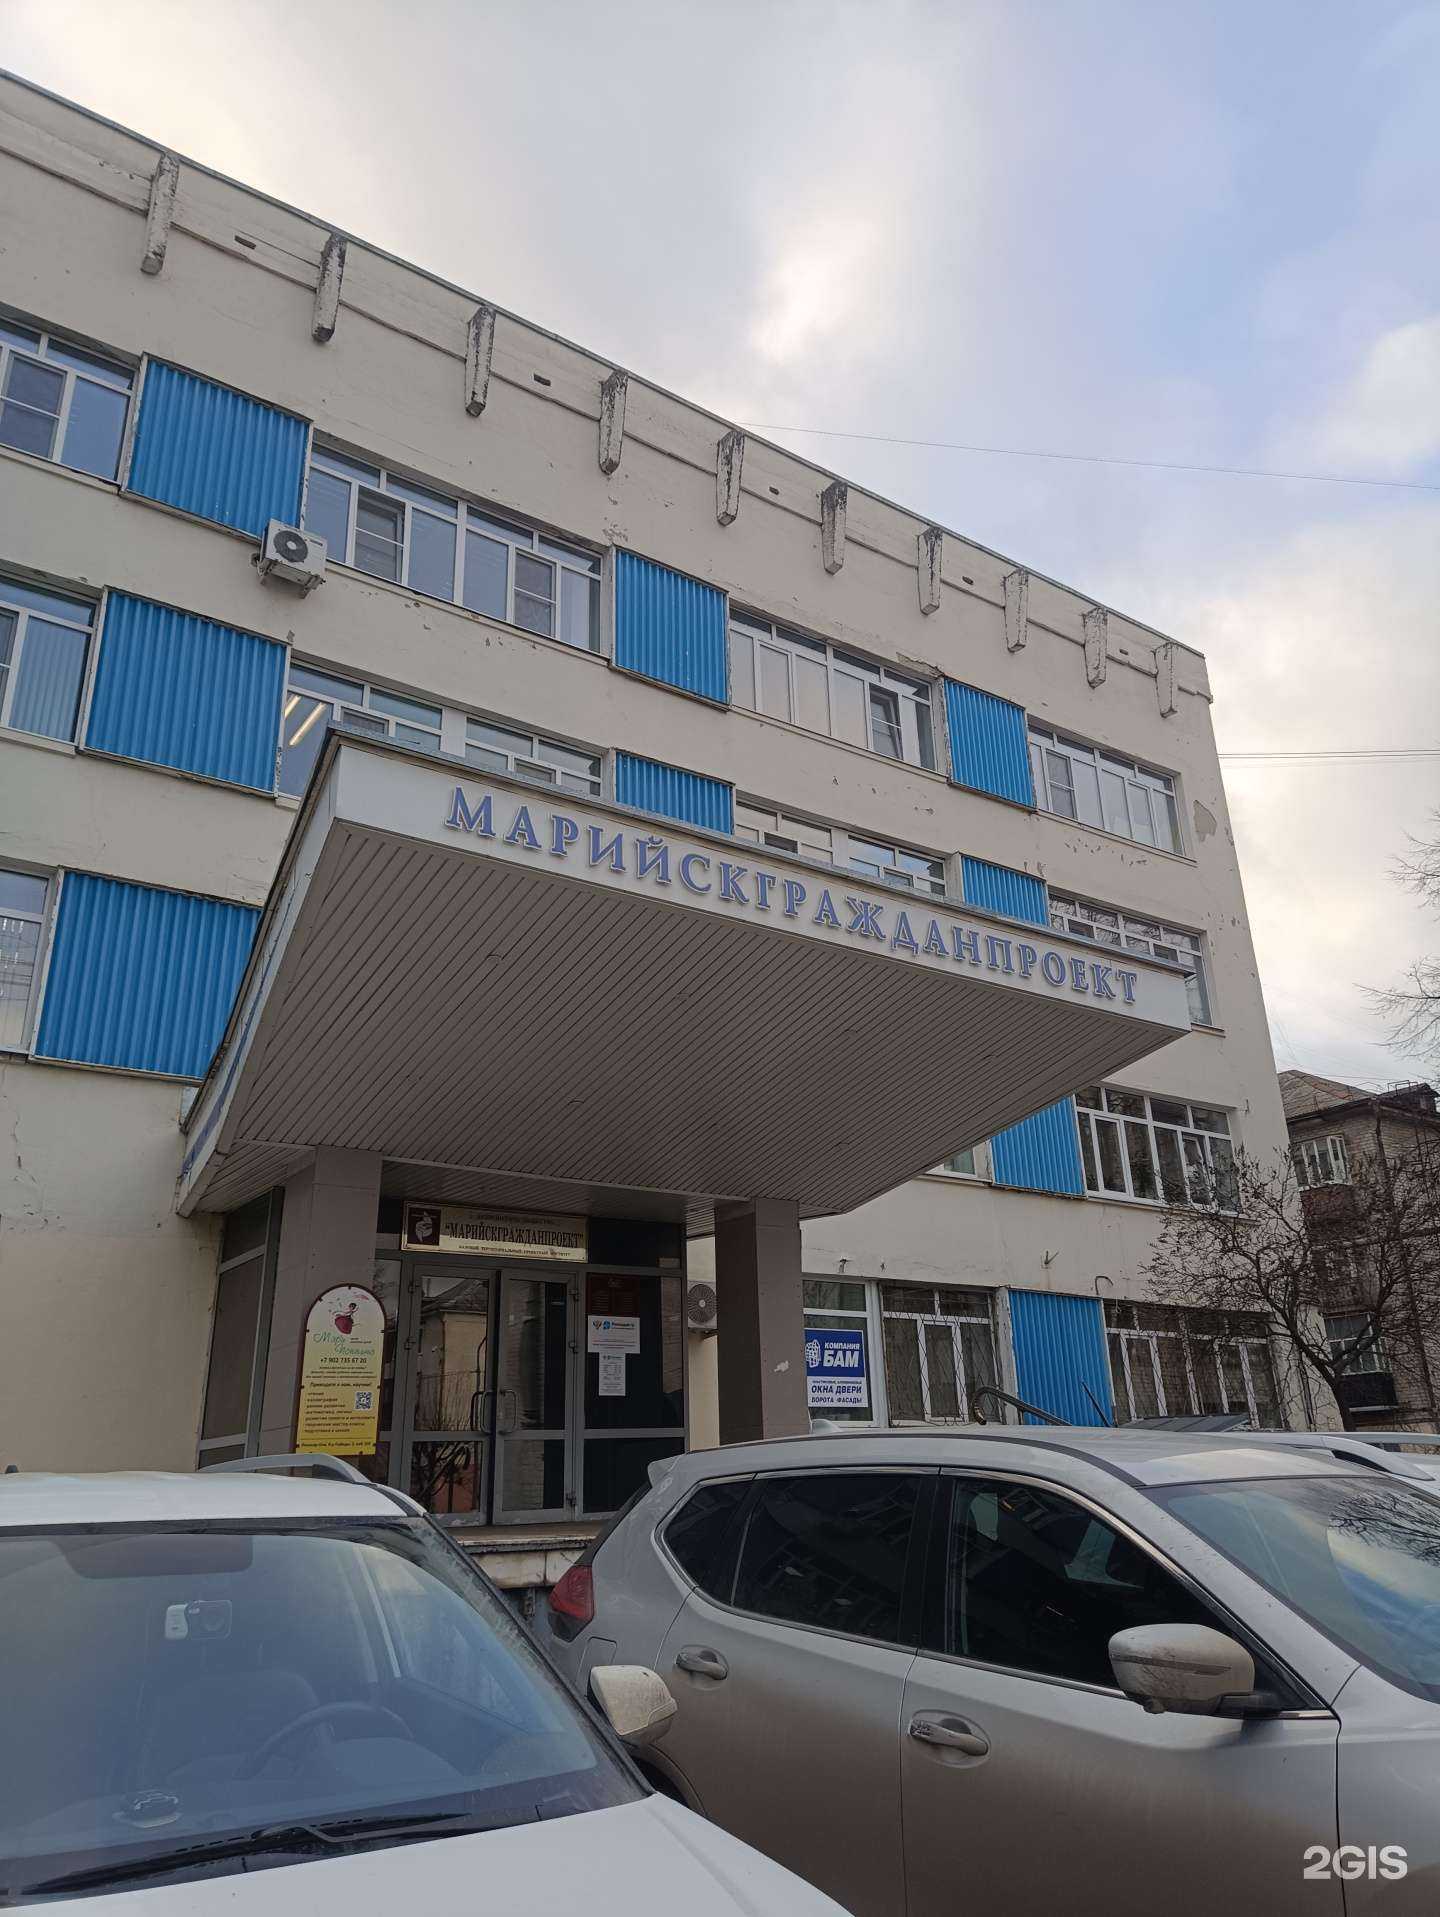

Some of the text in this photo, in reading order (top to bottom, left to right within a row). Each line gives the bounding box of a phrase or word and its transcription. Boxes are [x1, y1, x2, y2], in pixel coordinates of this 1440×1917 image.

[445, 786, 1138, 1004] МАРИЙСКГРАЖДАНПРОЕКТ
[824, 1342, 861, 1350] КОМПАНИЯ
[823, 1350, 860, 1367] БАМ
[811, 1385, 862, 1395] ОКНА ДВЕРИ
